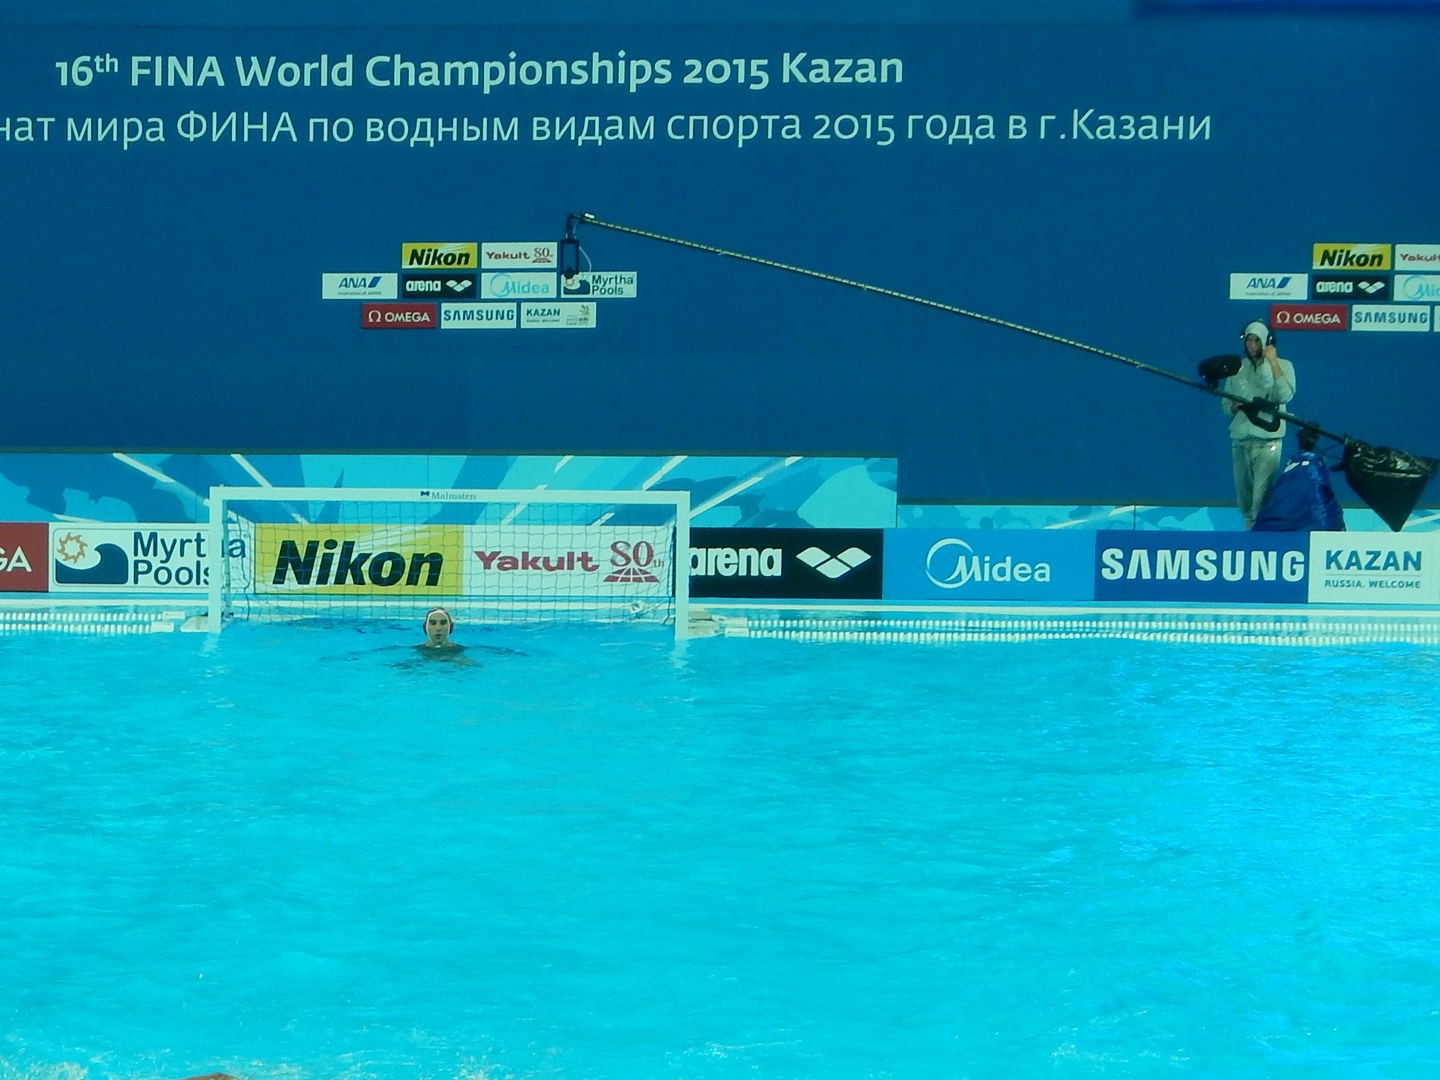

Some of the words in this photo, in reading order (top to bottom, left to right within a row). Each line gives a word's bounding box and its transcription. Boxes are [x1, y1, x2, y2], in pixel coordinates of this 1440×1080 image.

[56, 53, 118, 86] 16th
[132, 56, 224, 86] FINA
[235, 54, 352, 86] World
[366, 50, 671, 94] Championships
[684, 59, 769, 90] 2015
[783, 53, 902, 83] Kazan
[68, 118, 165, 150] мира
[177, 111, 297, 142] ФИНА
[310, 118, 353, 142] по
[367, 117, 518, 147] водным
[533, 116, 654, 146] видам
[668, 115, 801, 148] спорта
[813, 115, 894, 145] 2015
[908, 115, 995, 145] года
[1009, 115, 1027, 139] в
[1041, 109, 1210, 139] г.Казани
[409, 248, 470, 266] Nikon
[1319, 249, 1384, 267] Nikon
[339, 278, 366, 288] ANA
[406, 281, 441, 291] arena
[500, 279, 549, 294] Midea
[591, 274, 633, 287] Myrtha
[1247, 278, 1275, 288] ANA
[1316, 282, 1353, 293] arena
[591, 285, 624, 295] Pools
[385, 312, 430, 322] OMEGA
[444, 310, 514, 321] SAMSUNG
[1294, 313, 1340, 324] OMEGA
[1355, 312, 1427, 323] SAMSUNG
[431, 492, 477, 500] Malmsten
[132, 531, 246, 564] Myrta
[271, 539, 444, 586] Nikon
[473, 550, 600, 572] Yakult
[690, 547, 782, 576] arena
[950, 546, 1054, 584] Midea
[1102, 548, 1304, 581] SAMSUNG
[1326, 550, 1421, 571] KAZAN
